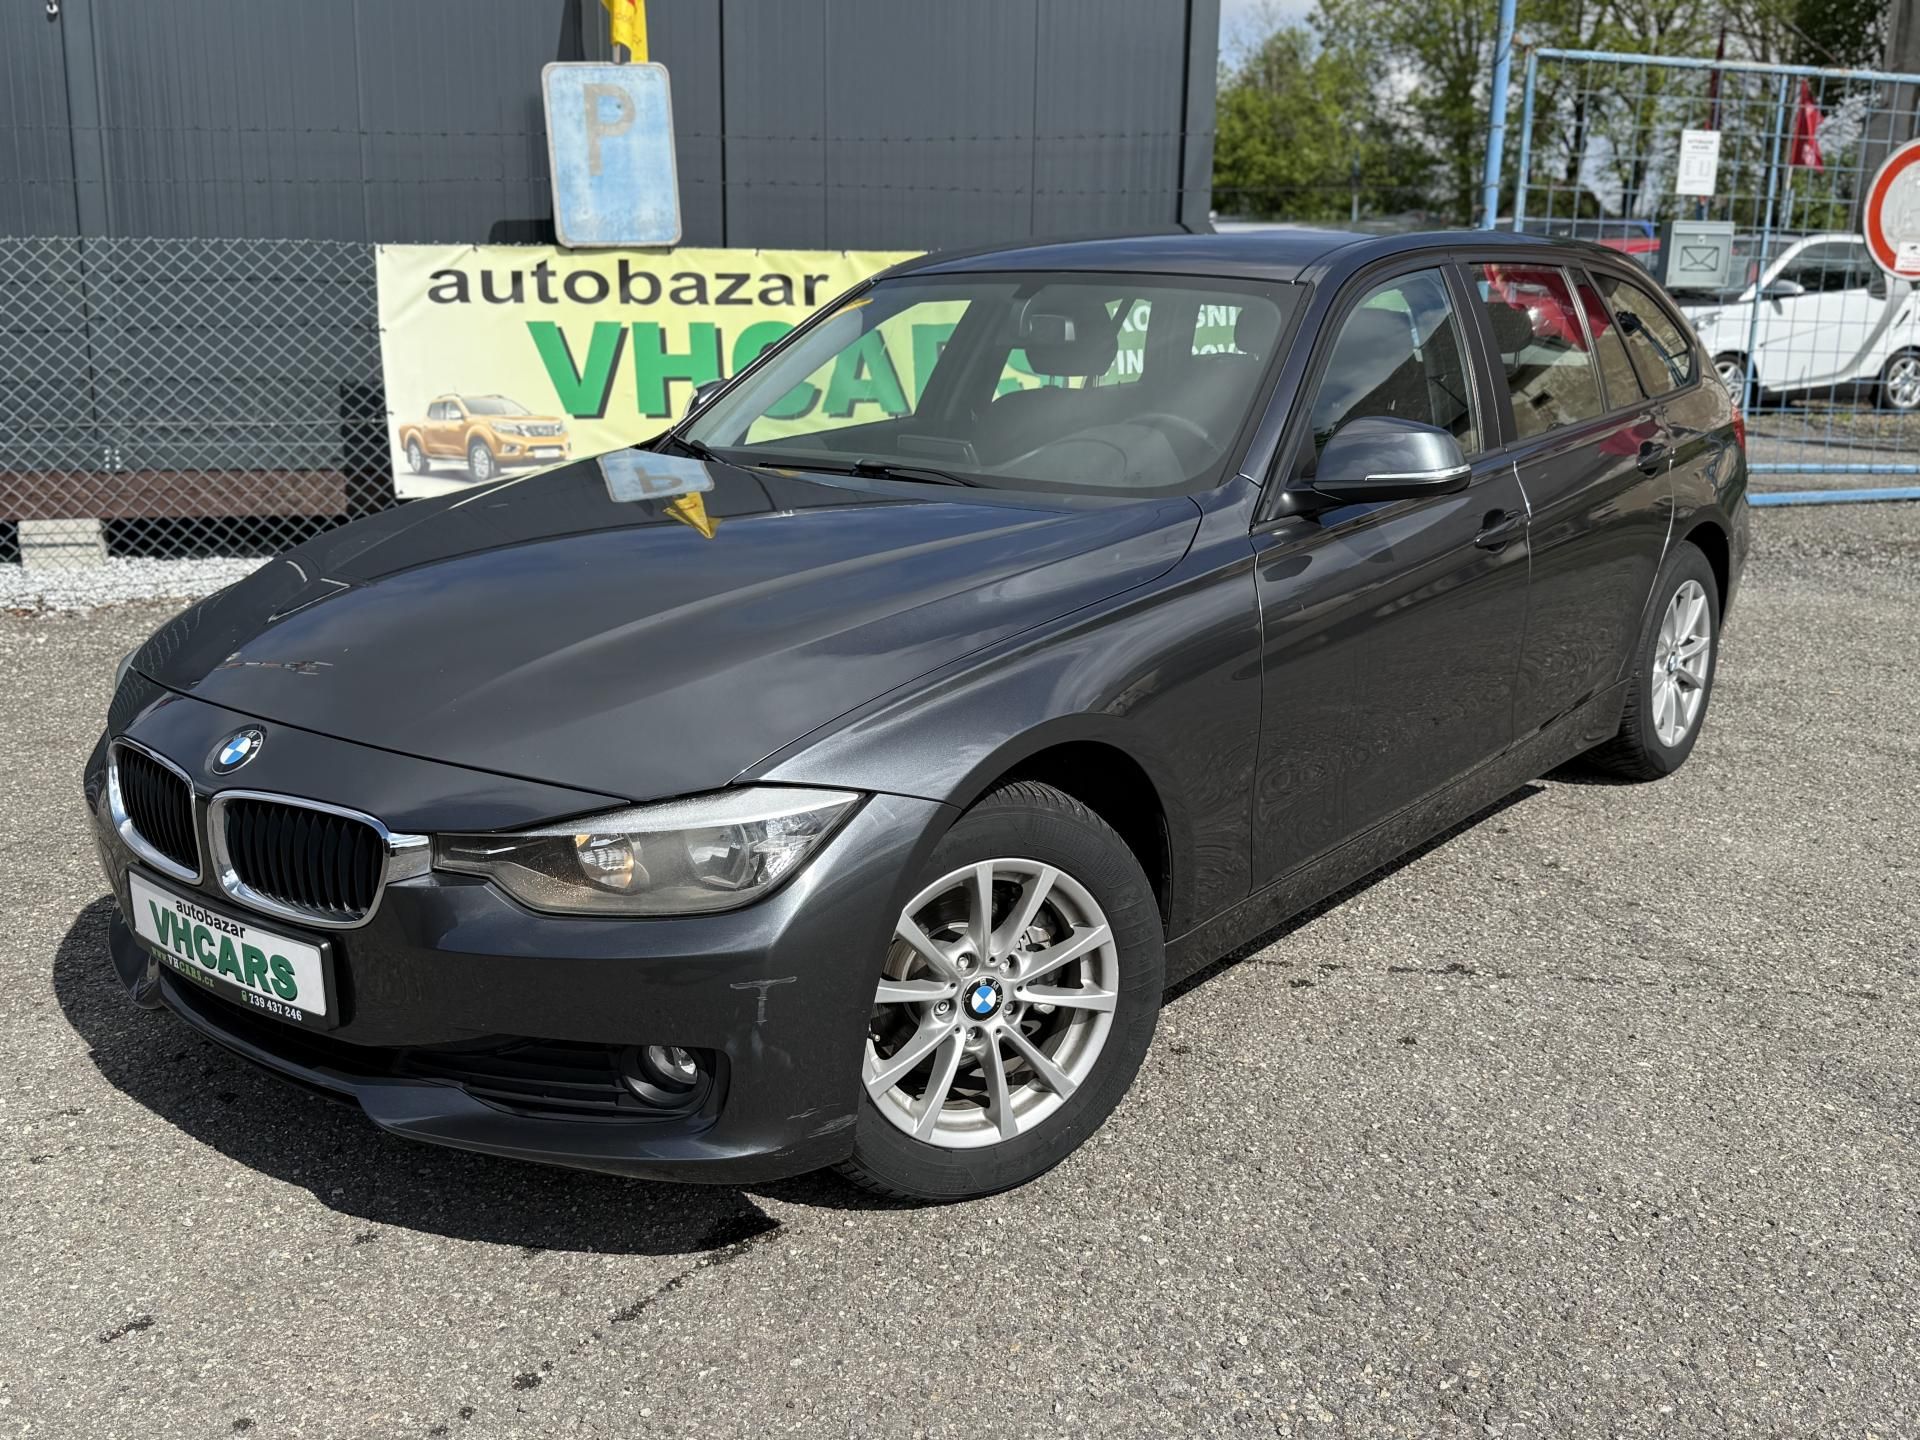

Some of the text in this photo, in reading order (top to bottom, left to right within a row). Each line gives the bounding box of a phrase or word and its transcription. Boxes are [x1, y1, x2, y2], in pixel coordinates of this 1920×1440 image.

[583, 83, 635, 176] P
[427, 259, 830, 306] autobazar
[176, 900, 246, 939] autobazar
[149, 900, 298, 1001] VHCARS
[249, 993, 303, 1021] 739 437 246
